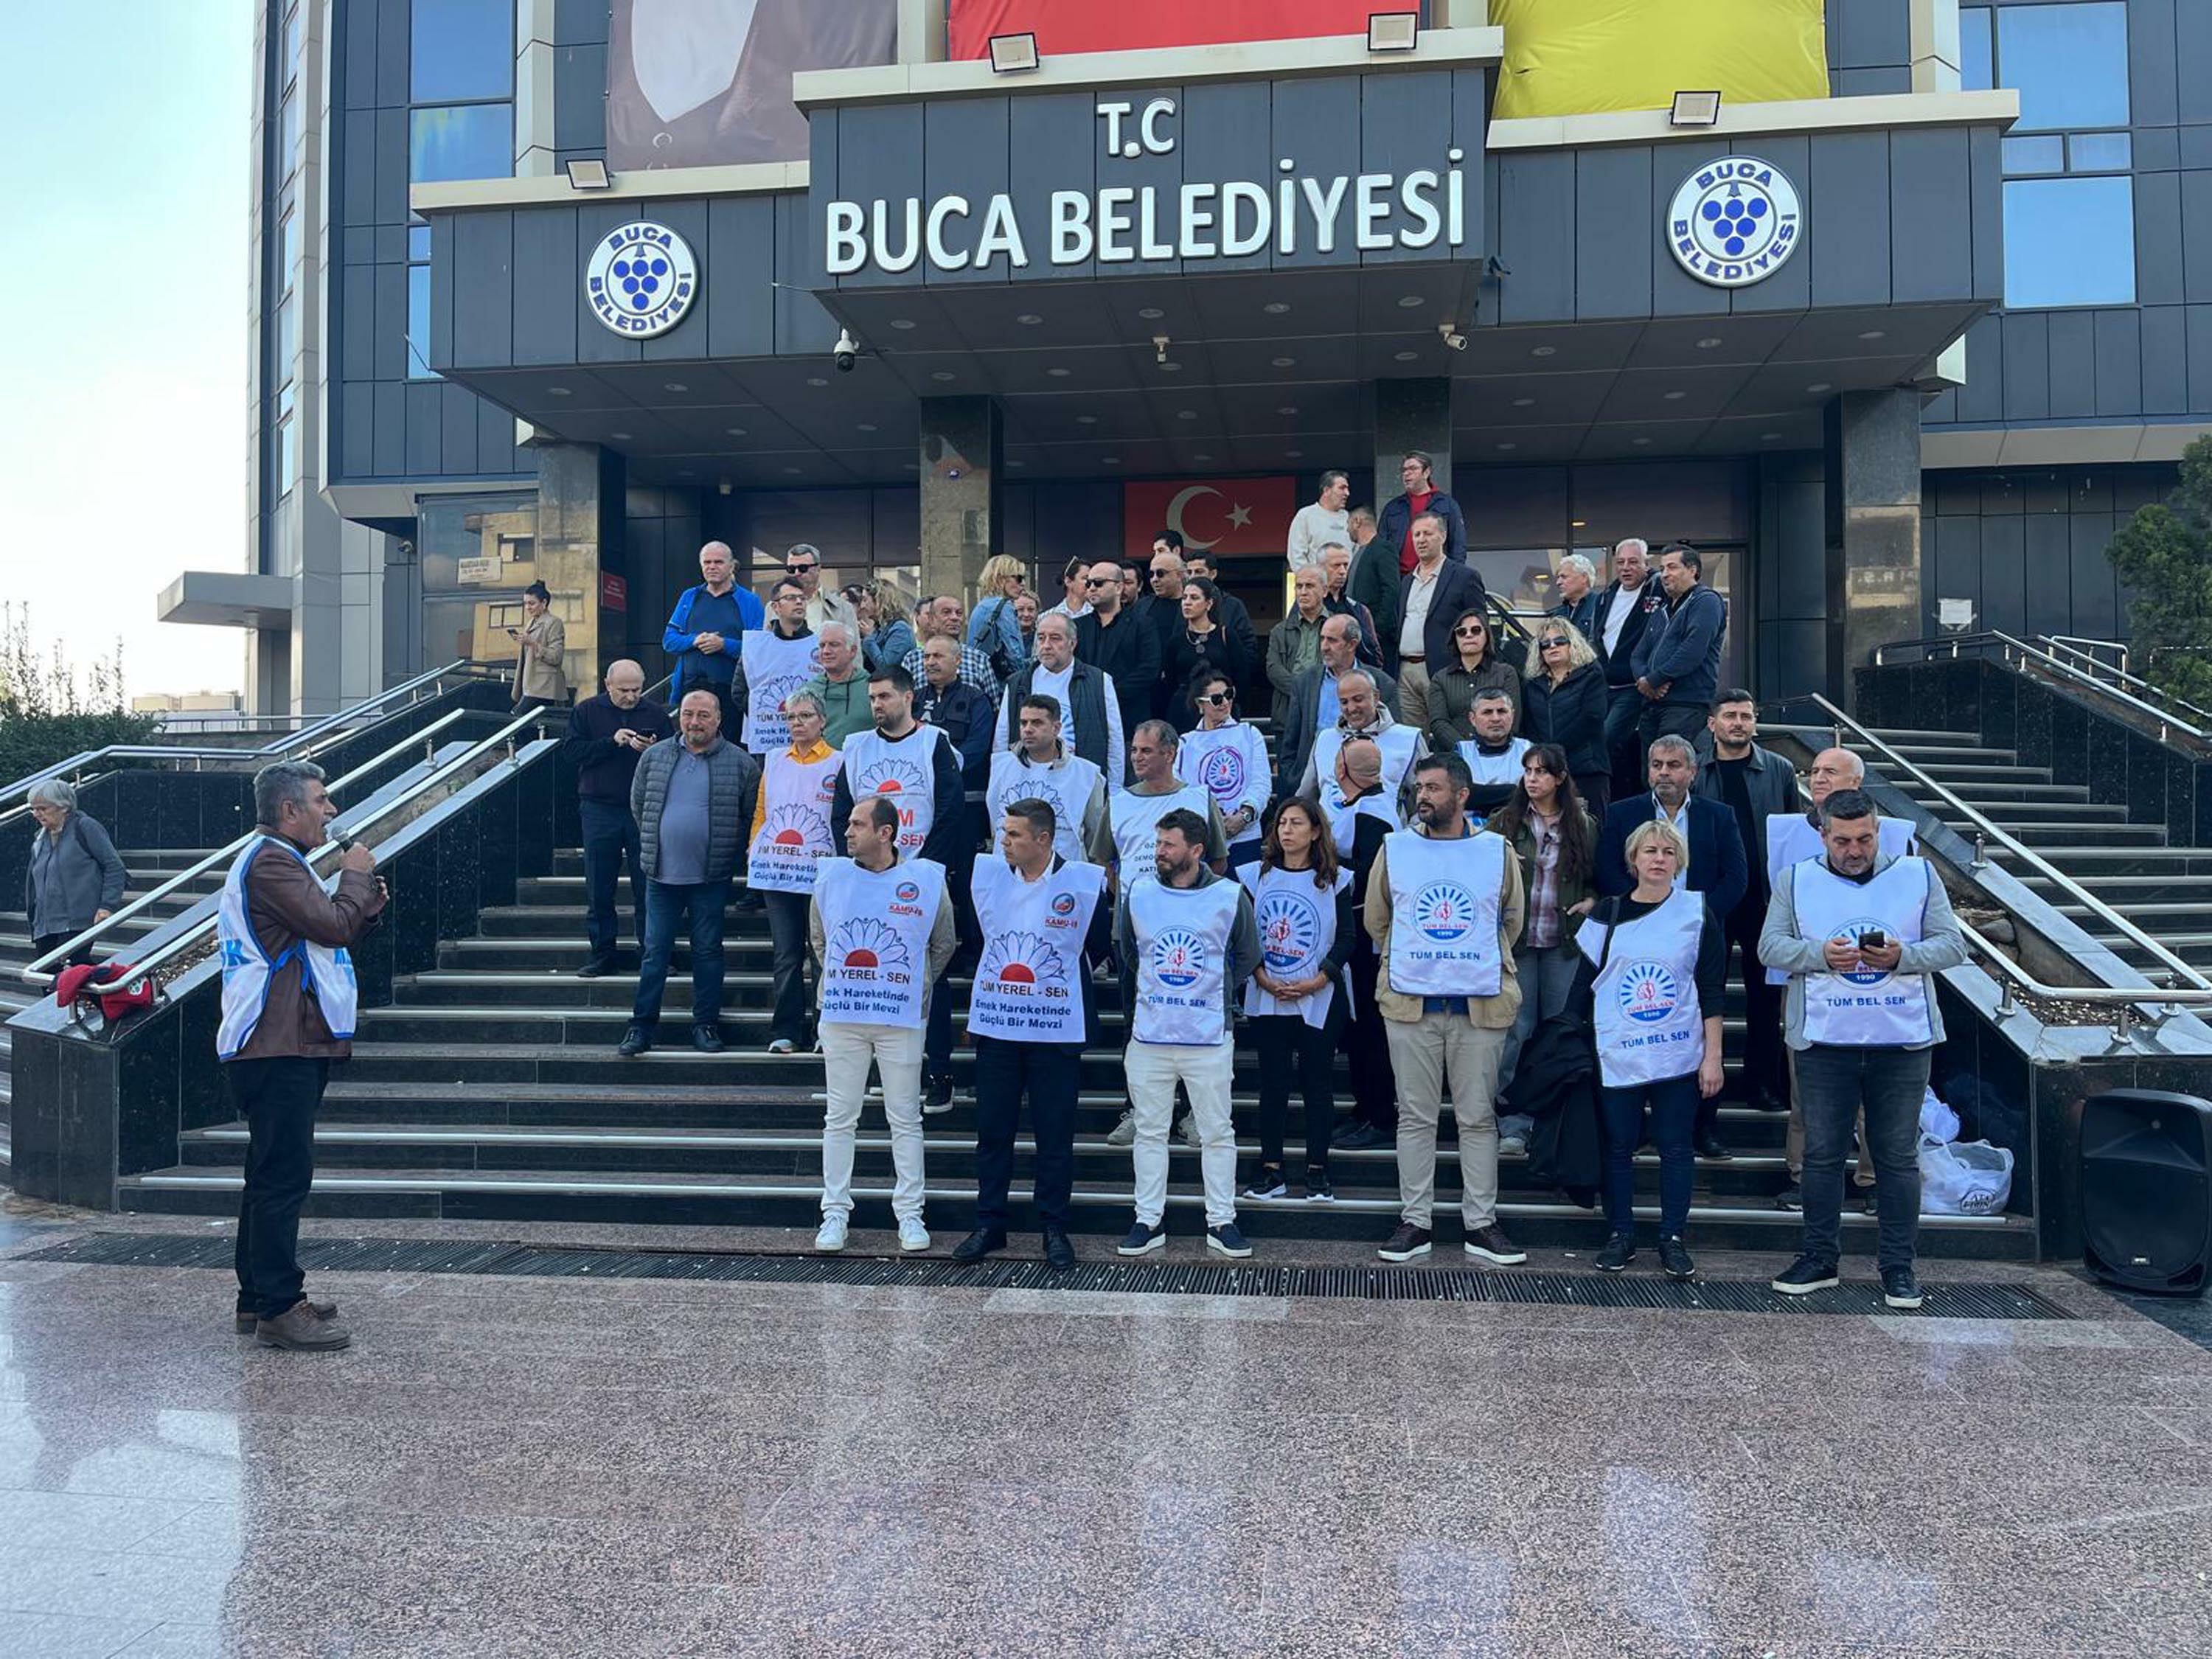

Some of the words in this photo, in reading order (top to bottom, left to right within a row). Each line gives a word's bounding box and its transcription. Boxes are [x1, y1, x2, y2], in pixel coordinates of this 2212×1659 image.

[1097, 98, 1177, 158] T.C
[1696, 163, 1772, 190] BUCA
[826, 194, 1029, 275] BUCA
[1051, 148, 1464, 265] BELEDİYESİ
[608, 226, 673, 251] BUCA
[773, 846, 802, 856] YEREL
[1436, 951, 1457, 959] BEL
[1459, 951, 1481, 960] SEN
[841, 969, 877, 981] YEREL
[887, 972, 910, 984] SEN
[844, 988, 909, 1003] Hareketinde
[996, 984, 1034, 996] YEREL
[1046, 987, 1068, 998] SEN
[824, 1000, 849, 1012] üçlü
[854, 1001, 870, 1012] Bir
[872, 1002, 900, 1015] Mevzi
[975, 998, 997, 1010] Emek
[1000, 1003, 1071, 1015] Hareketinde
[1166, 996, 1186, 1006] BEL
[1189, 998, 1206, 1007] SEN
[1857, 997, 1881, 1006] BEL
[1885, 995, 1906, 1005] SEN
[980, 1012, 1004, 1026] Güçlü
[1007, 1017, 1025, 1027] Bir
[1029, 1018, 1062, 1029] Mevzi
[1647, 1034, 1668, 1045] BEL
[1671, 1030, 1690, 1041] SEN
